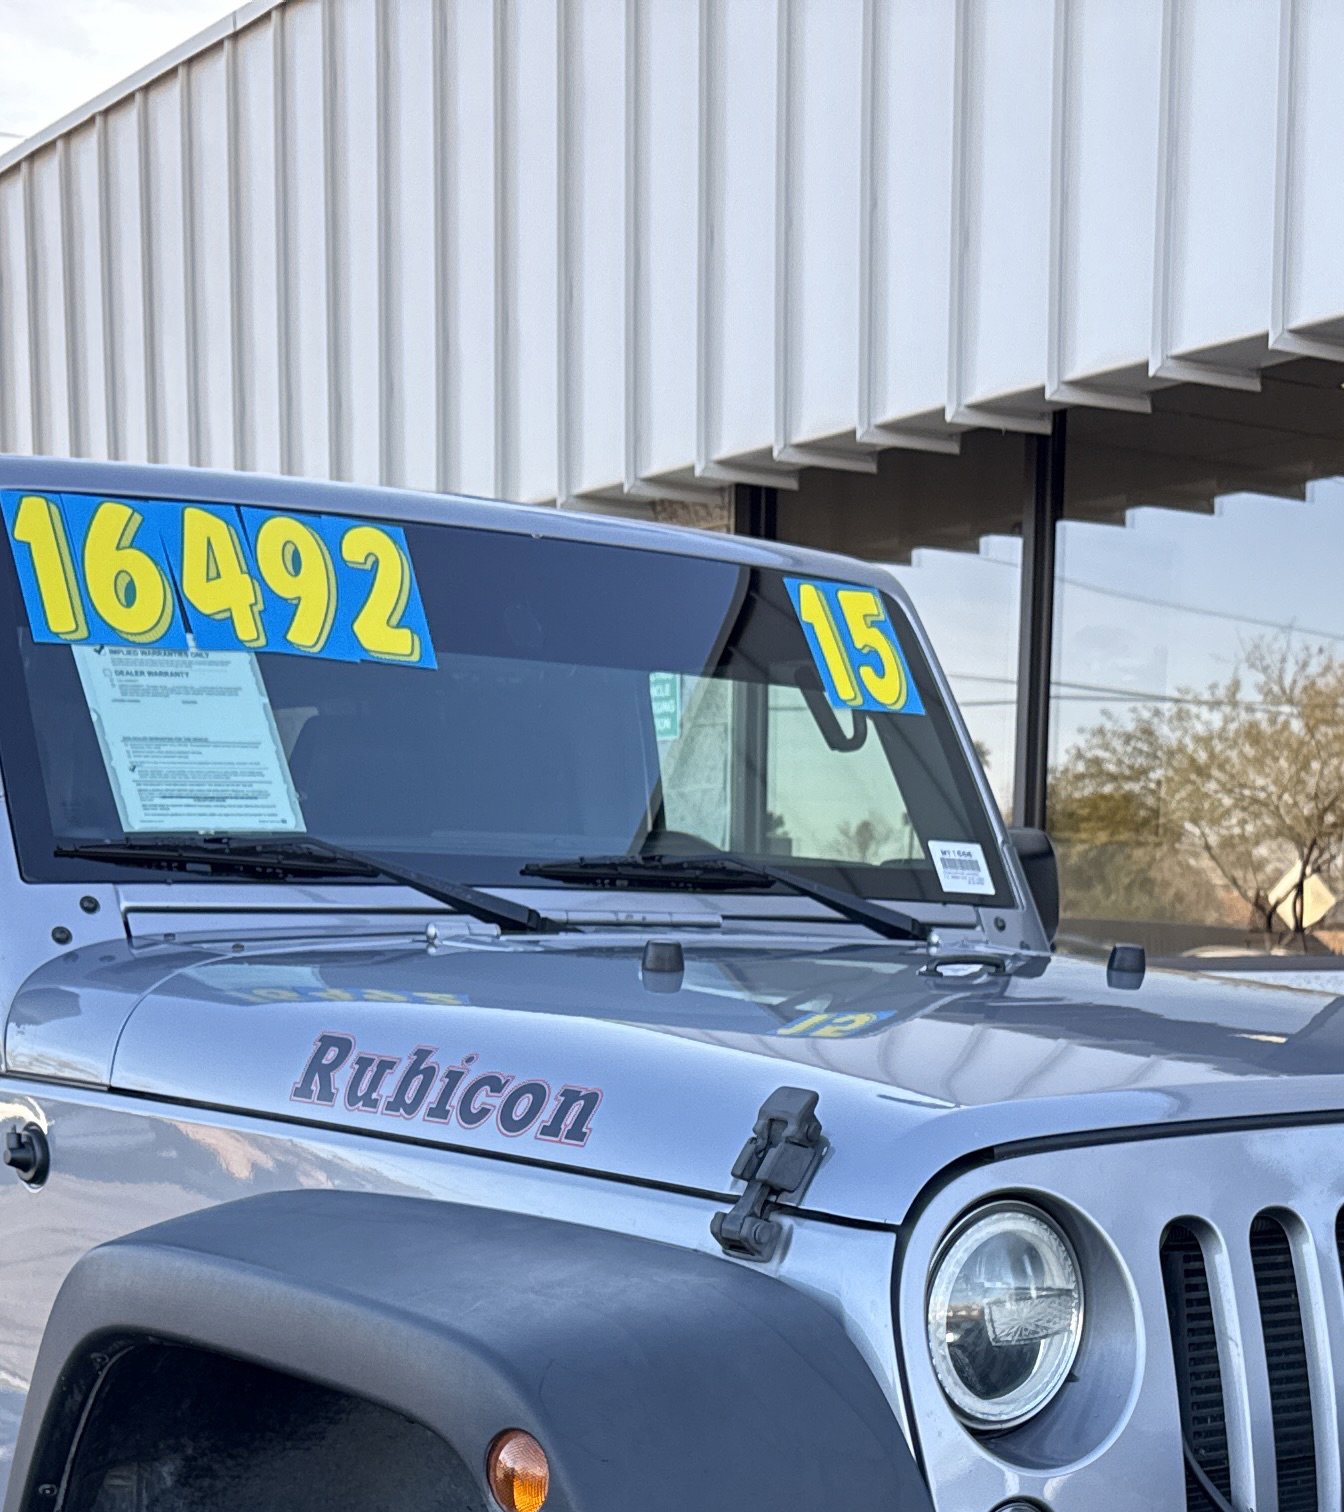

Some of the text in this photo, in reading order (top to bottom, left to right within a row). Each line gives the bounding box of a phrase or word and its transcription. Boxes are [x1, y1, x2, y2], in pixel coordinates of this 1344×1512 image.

[12, 495, 422, 663] 16492
[114, 669, 190, 679] DEALER WARRANTY
[798, 583, 908, 710] 15
[289, 1030, 604, 1147] Rubicon
